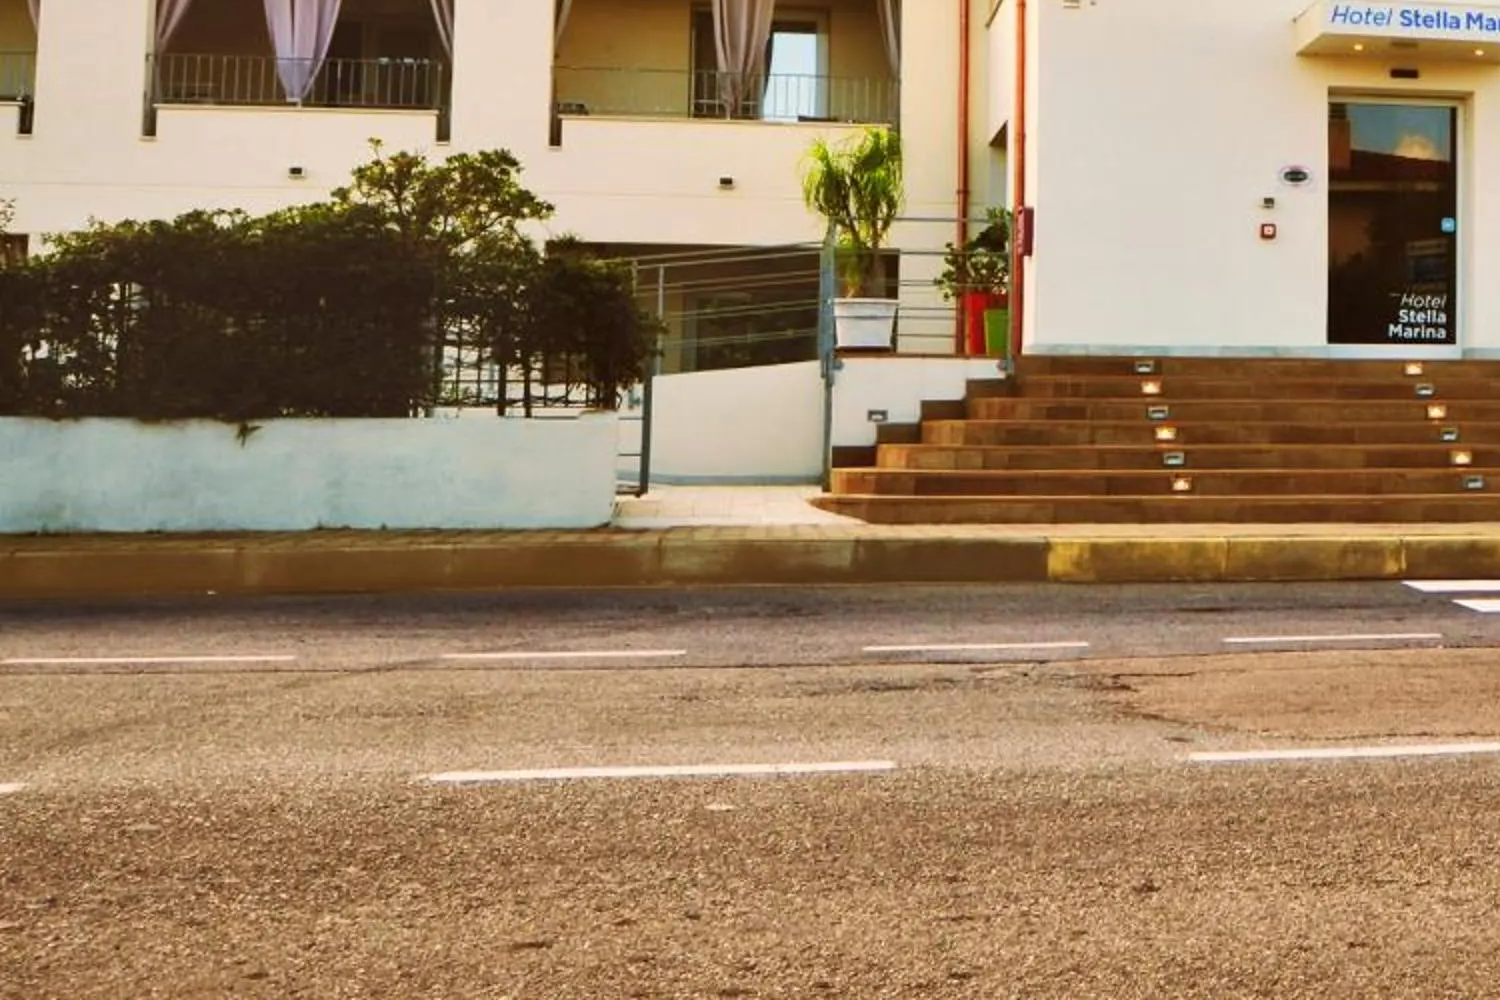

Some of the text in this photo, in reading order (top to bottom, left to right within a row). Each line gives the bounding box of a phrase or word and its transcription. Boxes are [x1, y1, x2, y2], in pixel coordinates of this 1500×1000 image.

[1331, 5, 1393, 26] Hotel
[1399, 9, 1460, 30] Stella
[1401, 293, 1448, 309] Hotel
[1398, 309, 1447, 324] Stella
[1388, 323, 1447, 339] Marina
